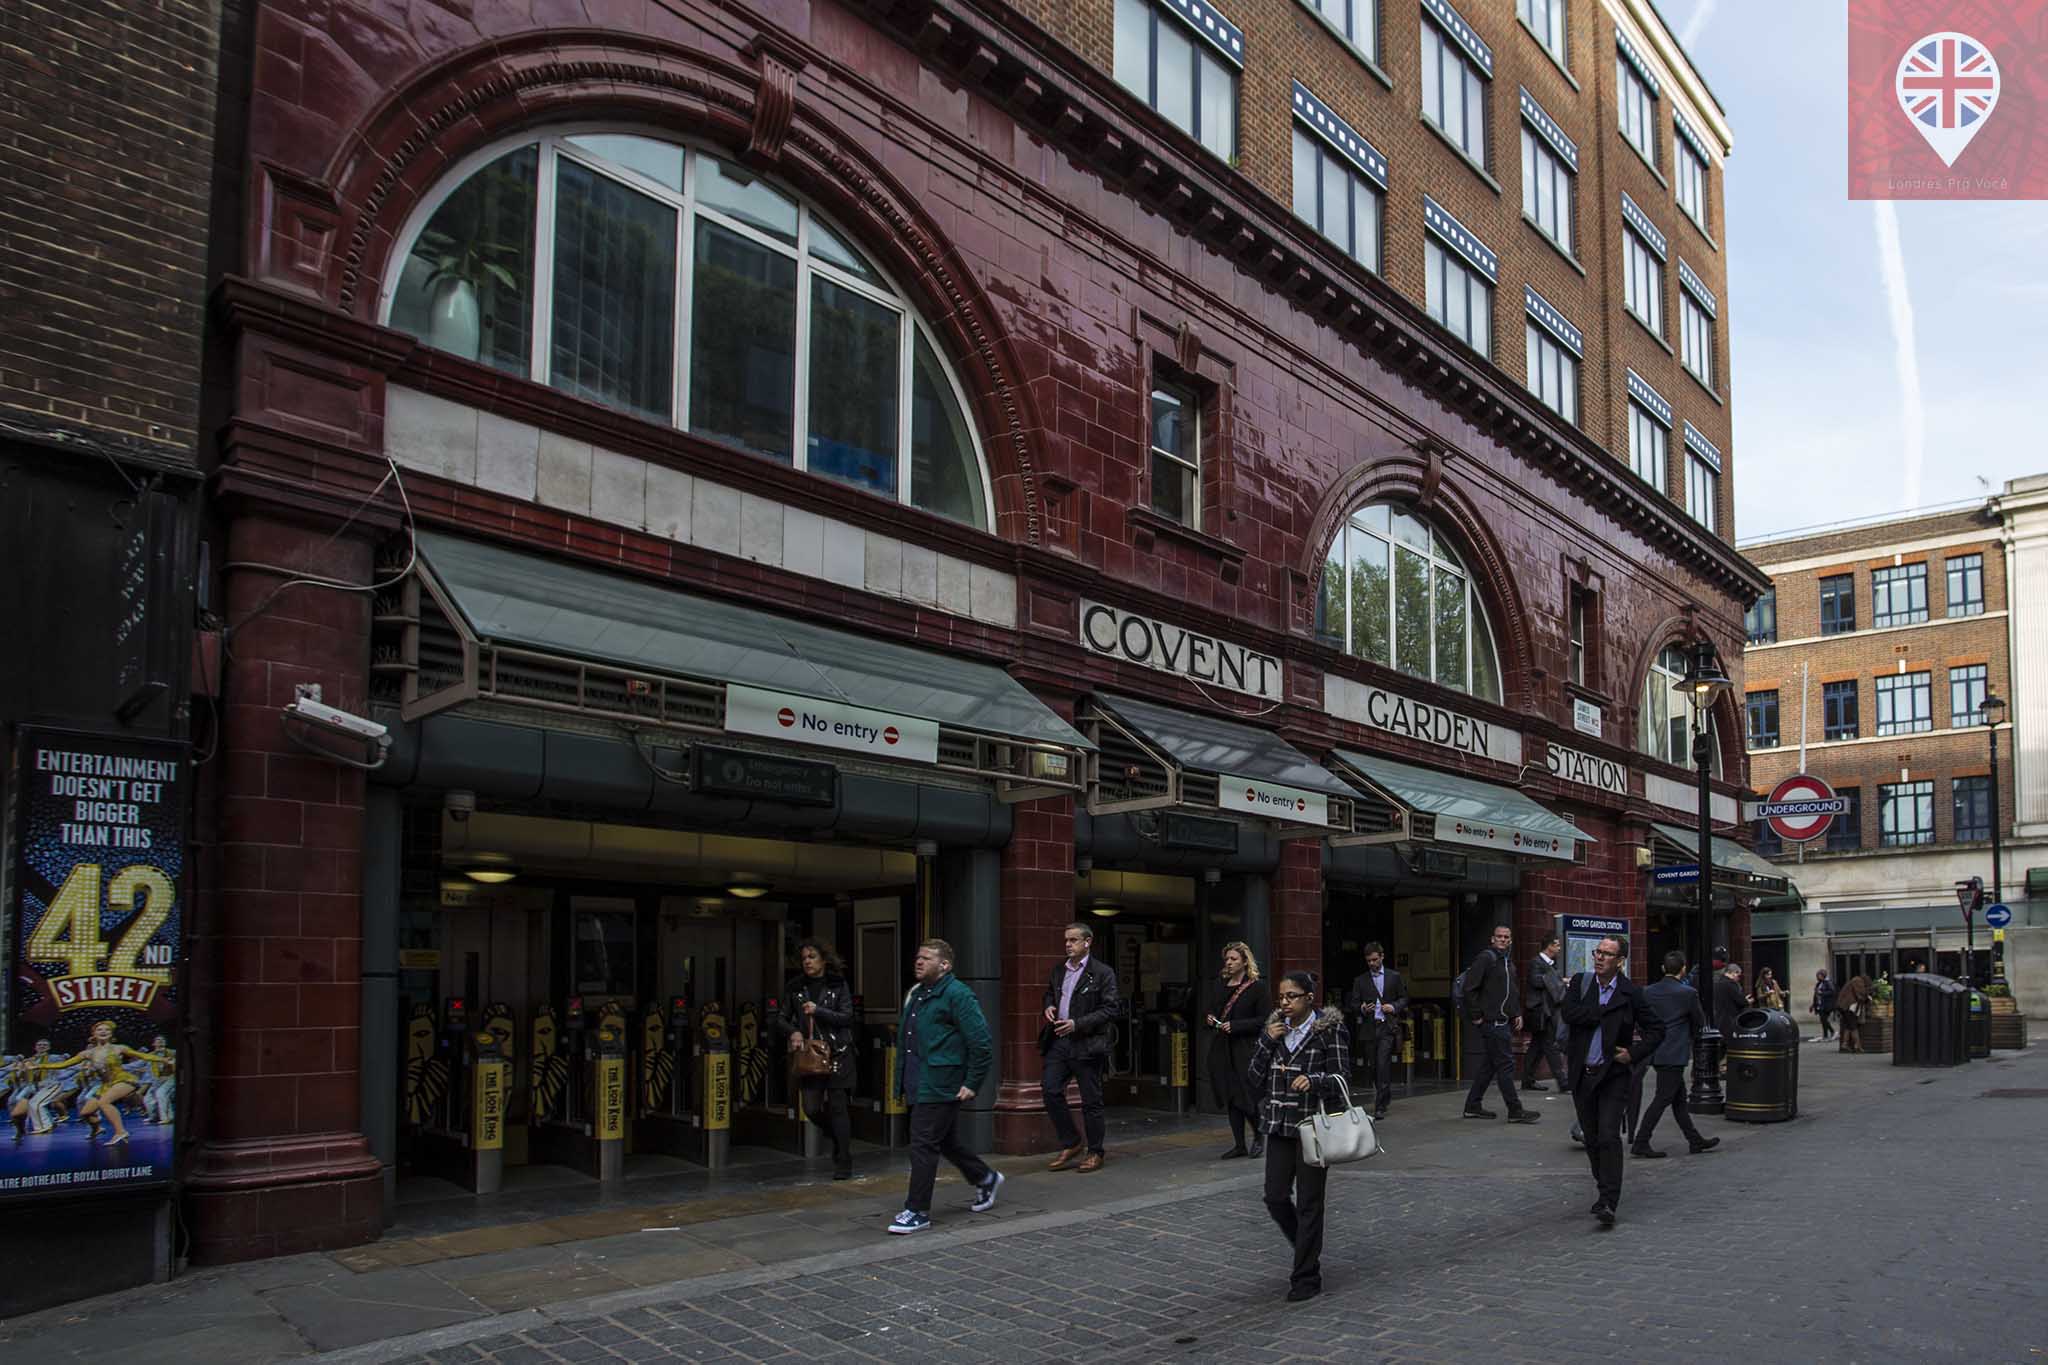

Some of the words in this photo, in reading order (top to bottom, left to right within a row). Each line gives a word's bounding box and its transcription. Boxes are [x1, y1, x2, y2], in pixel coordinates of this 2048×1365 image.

[1083, 604, 1278, 697] COVENT
[802, 712, 828, 732] No
[834, 722, 878, 743] entry
[1367, 690, 1489, 757] GARDEN
[36, 749, 177, 782] ENTERTAINMENT
[1546, 744, 1627, 793] STATION
[52, 775, 128, 800] DOESN'T
[131, 781, 163, 803] GET
[1257, 791, 1271, 804] No
[1272, 796, 1295, 811] entry
[75, 800, 140, 825] BIGGER
[1759, 801, 1842, 816] UNDERGROUND
[60, 823, 109, 846] THAN
[113, 826, 152, 849] THIS
[1463, 825, 1472, 834] No
[1472, 828, 1488, 840] entry
[1523, 836, 1532, 847] No
[1533, 838, 1550, 852] entry
[1657, 871, 1679, 880] COVENT
[1572, 919, 1590, 928] COVENT
[1590, 920, 1607, 929] GARDEN
[1607, 921, 1624, 930] STATION
[56, 976, 153, 1003] STREET
[73, 1170, 100, 1183] ROYAL
[102, 1167, 130, 1180] DRURY
[131, 1165, 153, 1178] LANE
